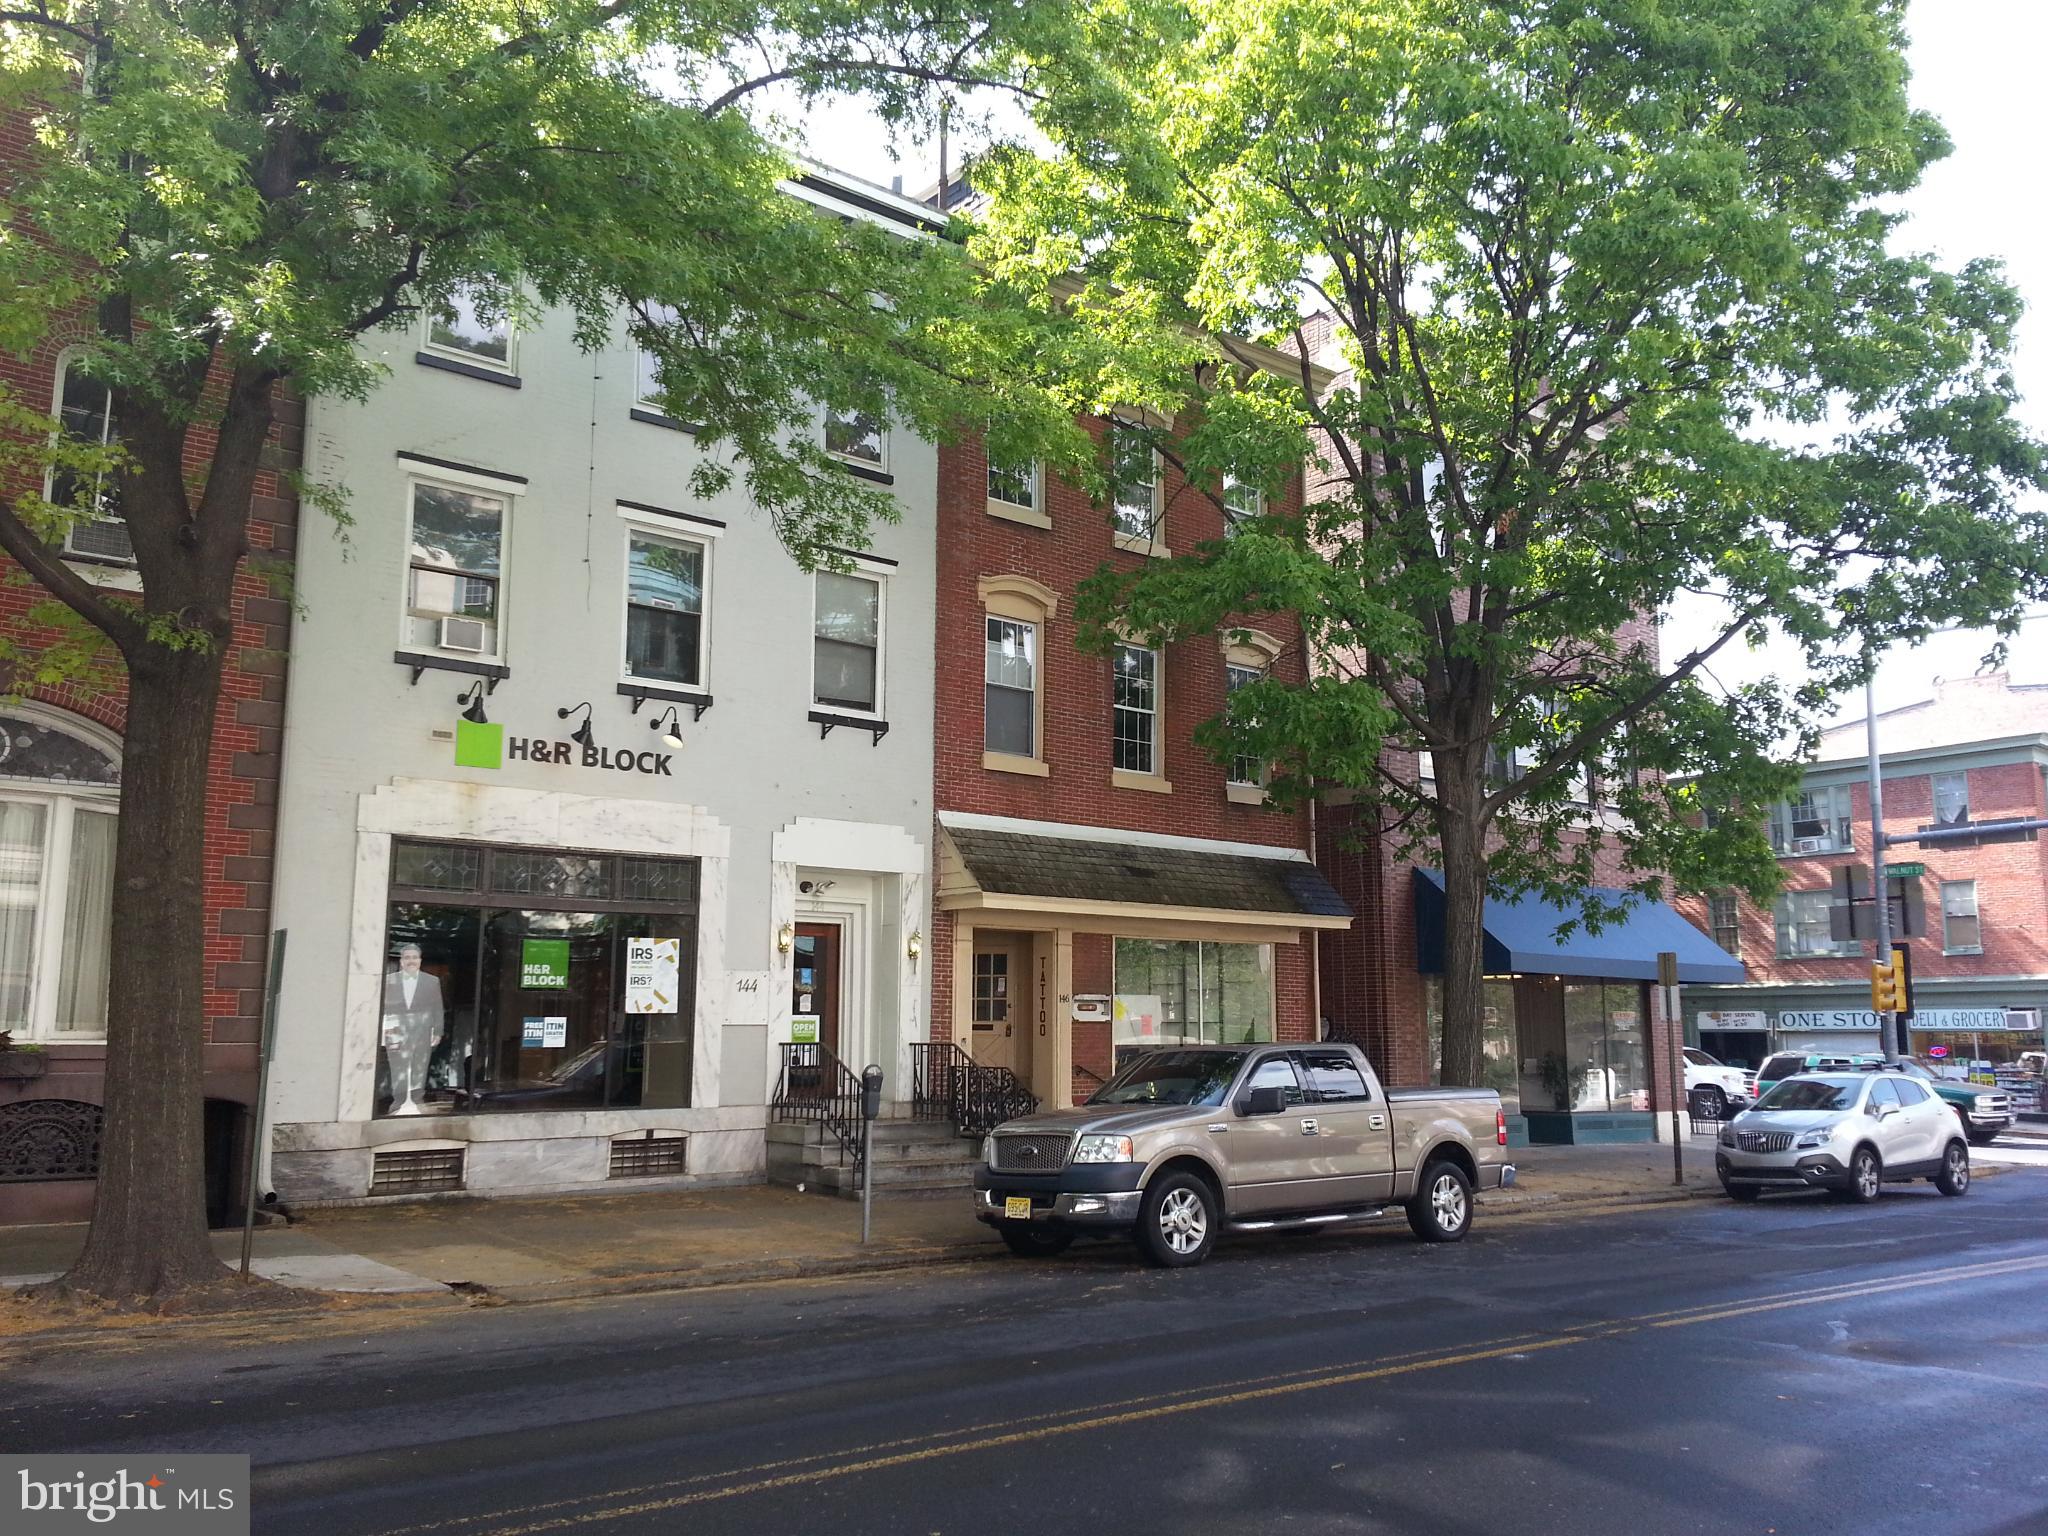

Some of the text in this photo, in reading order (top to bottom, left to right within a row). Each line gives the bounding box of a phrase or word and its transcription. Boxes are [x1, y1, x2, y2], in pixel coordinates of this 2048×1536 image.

[508, 736, 673, 776] H&R BLOCK
[631, 947, 653, 960] IRS
[524, 964, 551, 975] H&R
[523, 975, 566, 986] BLOCK
[630, 976, 653, 986] IRS?
[736, 978, 758, 993] 144
[1039, 956, 1047, 1037] TATTOO
[1059, 994, 1070, 1004] 146
[1782, 1012, 1880, 1027] ONE STO
[1912, 1011, 2006, 1027] DELI & GROCERY
[546, 1022, 565, 1030] ITIN
[792, 1023, 815, 1031] OPEN
